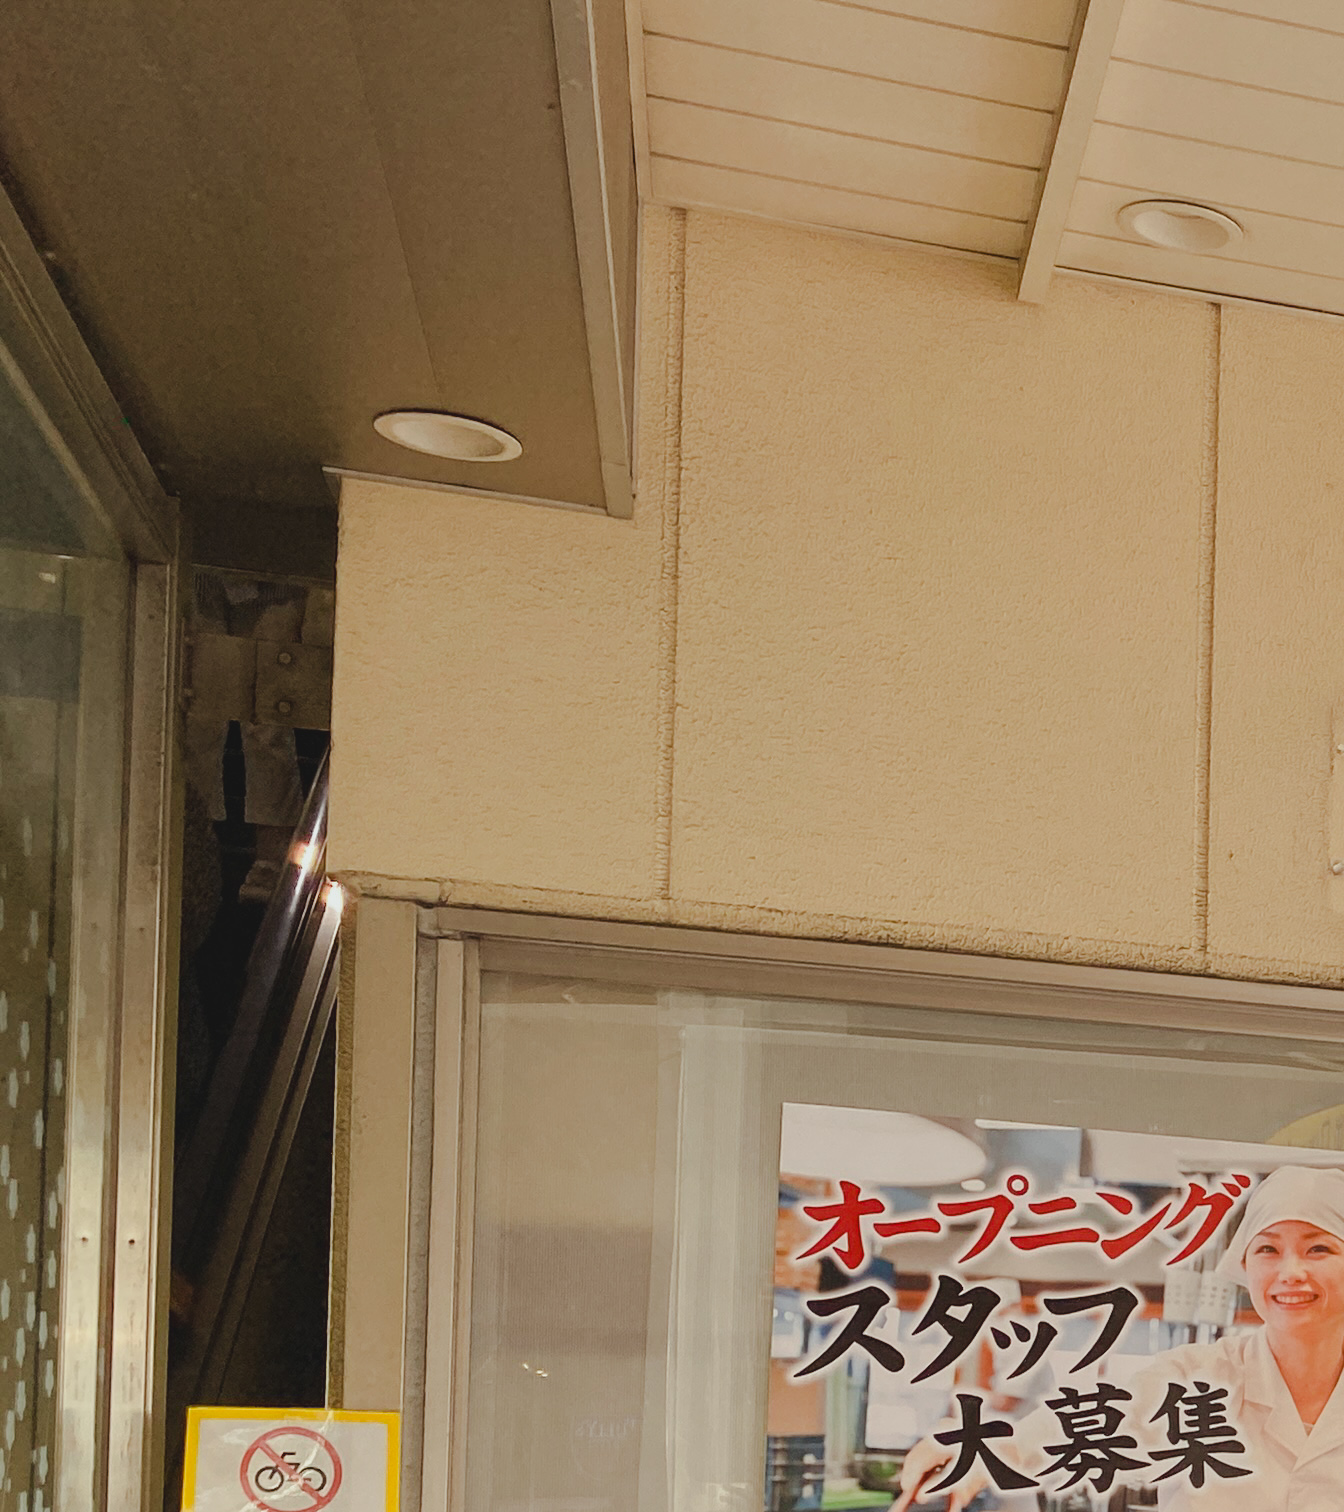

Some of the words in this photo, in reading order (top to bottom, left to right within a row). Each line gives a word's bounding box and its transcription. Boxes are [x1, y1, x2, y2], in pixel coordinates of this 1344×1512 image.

[795, 1174, 1251, 1269] オープニング
[793, 1275, 1139, 1384] スタッフ
[926, 1383, 1253, 1495] 大募集
